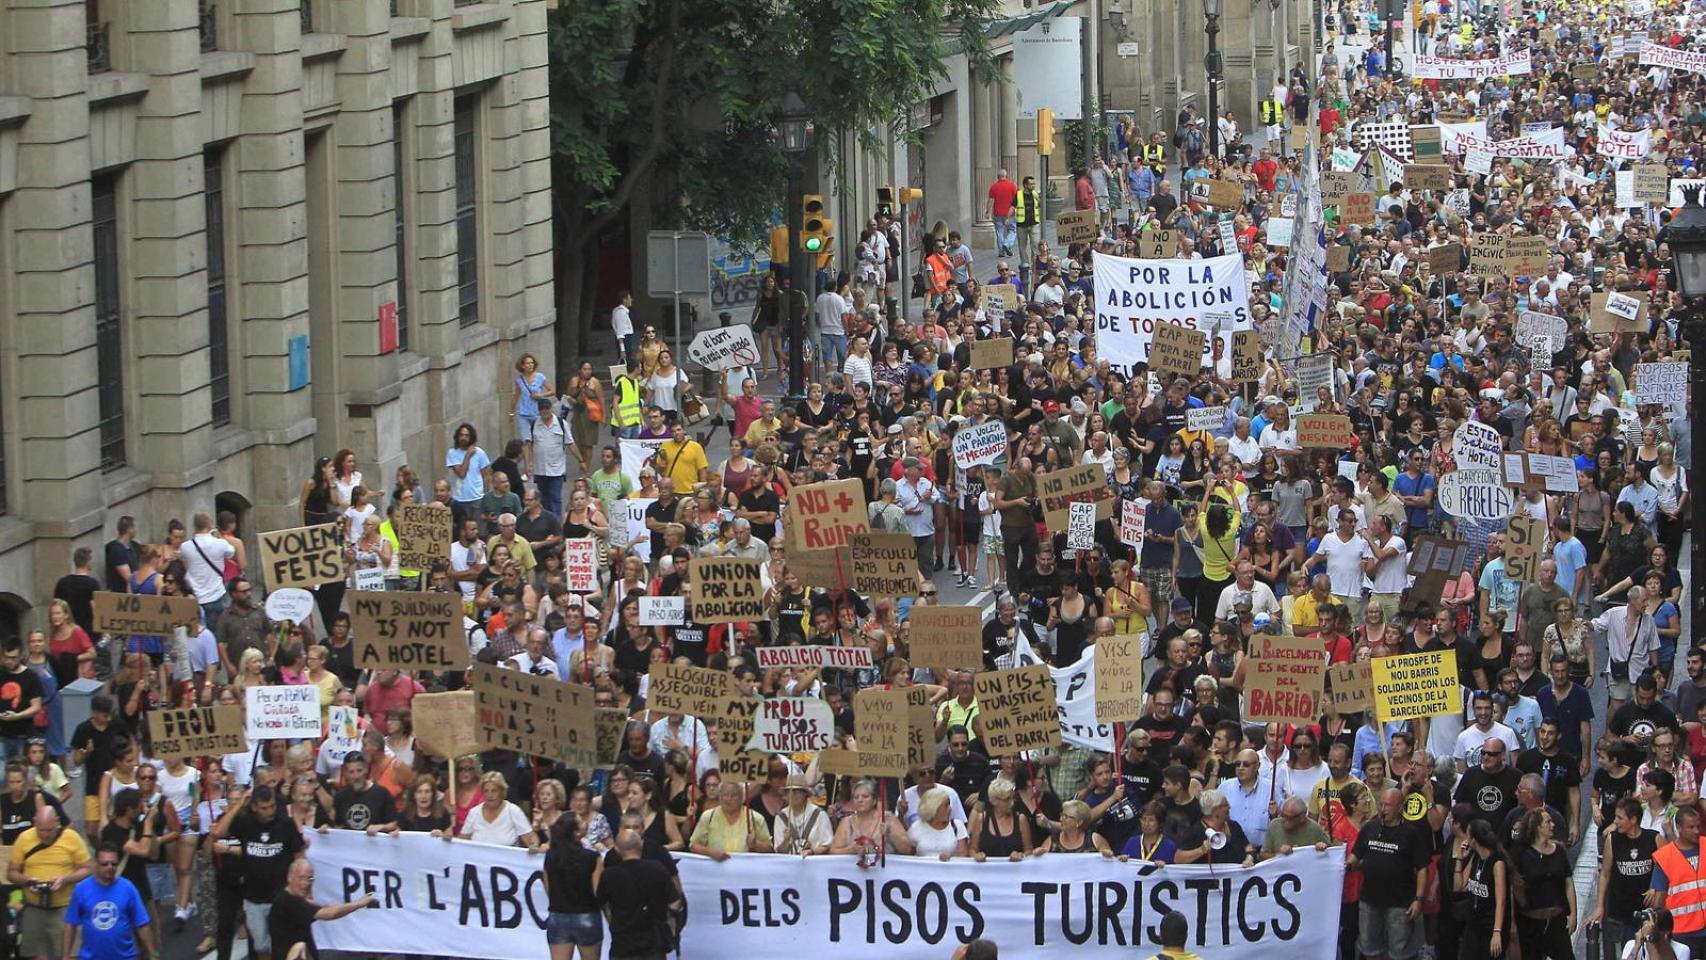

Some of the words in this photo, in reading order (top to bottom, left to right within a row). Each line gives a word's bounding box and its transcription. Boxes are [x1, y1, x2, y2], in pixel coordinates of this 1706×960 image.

[1438, 67, 1455, 77] TU
[1468, 64, 1508, 77] TRIAS
[1609, 131, 1633, 144] NO
[1598, 137, 1644, 157] HOTEL
[1152, 231, 1170, 242] NO
[1478, 235, 1504, 246] STOP
[1154, 244, 1163, 255] A
[1129, 266, 1171, 285] POR
[1188, 265, 1214, 284] LA
[1108, 285, 1233, 309] ABOLICIÓN
[1099, 312, 1121, 333] DE
[1158, 326, 1182, 342] CAP
[1234, 333, 1247, 346] NO
[703, 337, 713, 349] el
[1154, 342, 1180, 356] FORA
[1182, 349, 1201, 360] DEL
[1232, 348, 1245, 358] AL
[1234, 356, 1254, 368] PLA
[1637, 363, 1652, 375] NO
[957, 431, 972, 444] NO
[975, 423, 1000, 437] VOLEM
[1303, 420, 1346, 431] VOLEM
[1466, 423, 1500, 443] ESTEM
[956, 442, 969, 453] UN
[971, 431, 1006, 450] PARKING
[1043, 478, 1064, 495] NO
[1069, 468, 1097, 487] NOS
[1443, 474, 1454, 486] LA
[795, 488, 830, 516] NO
[1071, 504, 1094, 513] CAP
[264, 524, 338, 555] VOLEM
[853, 535, 871, 548] NO
[1122, 526, 1143, 543] FETS
[401, 538, 414, 551] DE
[427, 543, 441, 555] LA
[852, 548, 918, 561] ESPECULEU
[274, 549, 340, 584] FETS
[854, 561, 878, 573] AMB
[888, 561, 906, 573] LA
[701, 582, 728, 599] POR
[732, 580, 755, 597] LA
[856, 576, 918, 594] BARCELONETA
[116, 597, 140, 612] NO
[160, 600, 172, 615] A
[355, 599, 382, 617] MY
[391, 597, 452, 617] BUILDING
[375, 618, 398, 639] IS
[407, 621, 451, 639] NOT
[362, 642, 381, 664] A
[387, 642, 454, 666] HOTEL
[759, 646, 824, 667] ABOLICIÓ
[826, 648, 871, 667] TOTAL
[1386, 658, 1398, 670] LA
[1398, 655, 1430, 669] PROSPE
[1431, 654, 1442, 665] DE
[1258, 662, 1273, 673] ES
[1290, 664, 1320, 675] GENTE
[1339, 669, 1355, 682] LA
[1390, 670, 1410, 681] NOU
[1410, 666, 1440, 679] BARRIS
[665, 666, 728, 689] LLOGUER
[976, 676, 1001, 694] UN
[1006, 671, 1033, 691] PIS
[1276, 676, 1298, 686] DEL
[1377, 681, 1420, 695] SOLIDARIA
[1420, 678, 1439, 690] CON
[1440, 676, 1457, 688] LOS
[1120, 680, 1134, 693] LA
[1352, 689, 1366, 701] LA
[655, 696, 682, 710] PELS
[1387, 694, 1424, 706] VECINOS
[1424, 692, 1437, 703] DE
[1437, 690, 1448, 700] LA
[727, 701, 758, 716] MY
[763, 699, 804, 719] PROU
[1390, 702, 1449, 718] BARCELONETA
[162, 708, 217, 738] PROU
[717, 716, 755, 731] BUILDI
[985, 715, 1011, 731] UNA
[1016, 704, 1060, 725] FAMÍLIA
[779, 718, 818, 735] PISOS
[153, 737, 181, 754] PISOS
[185, 733, 240, 751] TURISTICS
[721, 733, 737, 745] IS
[880, 733, 895, 750] LA
[989, 733, 1013, 749] DEL
[1015, 727, 1050, 747] BARRI
[719, 757, 769, 782] HOTEL
[342, 866, 405, 909] PER
[719, 886, 800, 927] DELS
[827, 876, 985, 945] PISOS
[1020, 863, 1304, 947] TURÍSTICS
